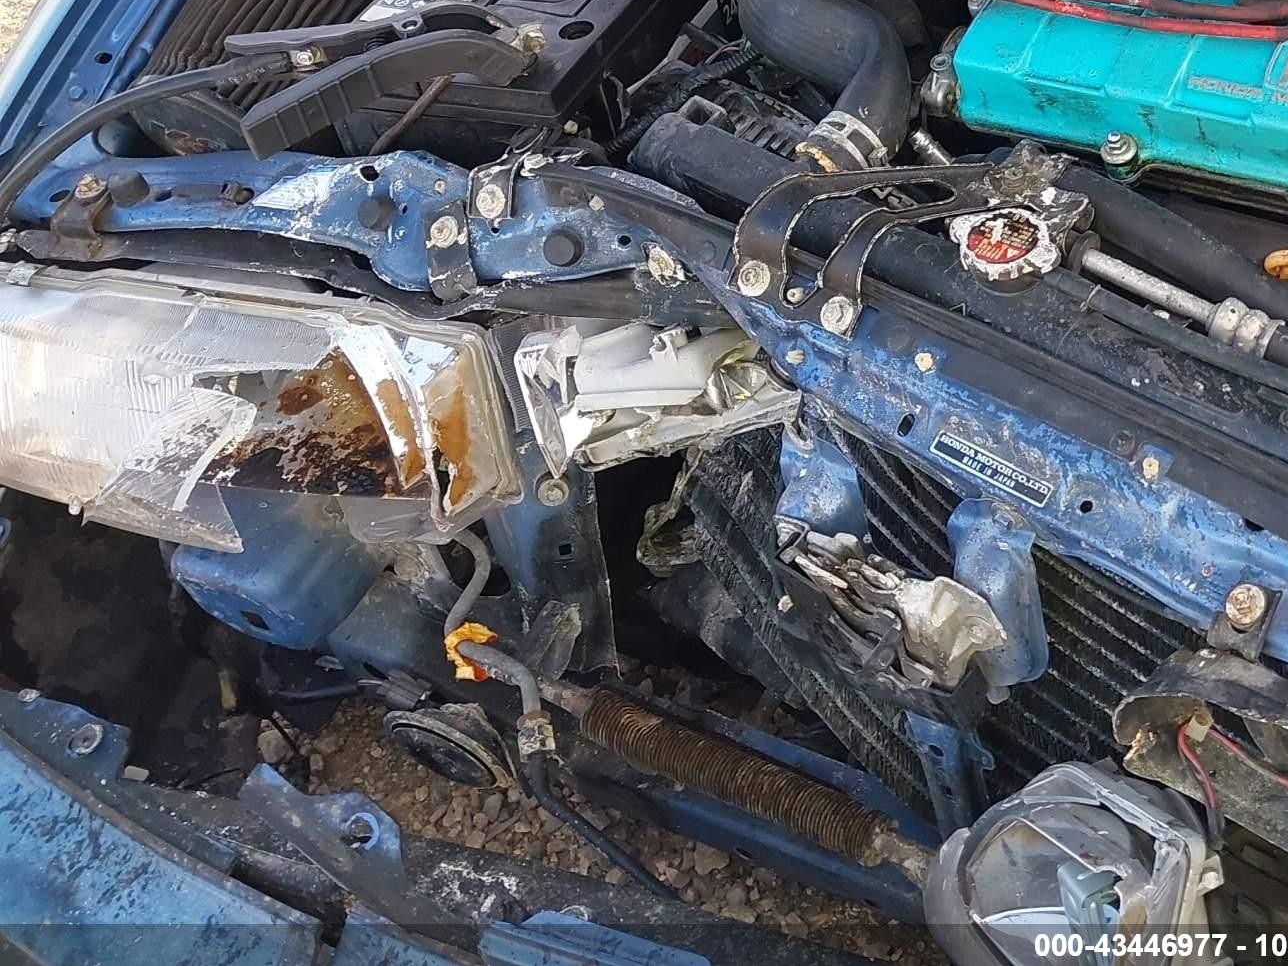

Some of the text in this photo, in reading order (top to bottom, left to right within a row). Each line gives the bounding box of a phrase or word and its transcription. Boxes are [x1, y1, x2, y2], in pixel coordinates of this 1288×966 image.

[940, 434, 975, 458] HONDA
[975, 452, 1012, 477] MOTOR
[961, 454, 1016, 488] MADE IN JAPAN
